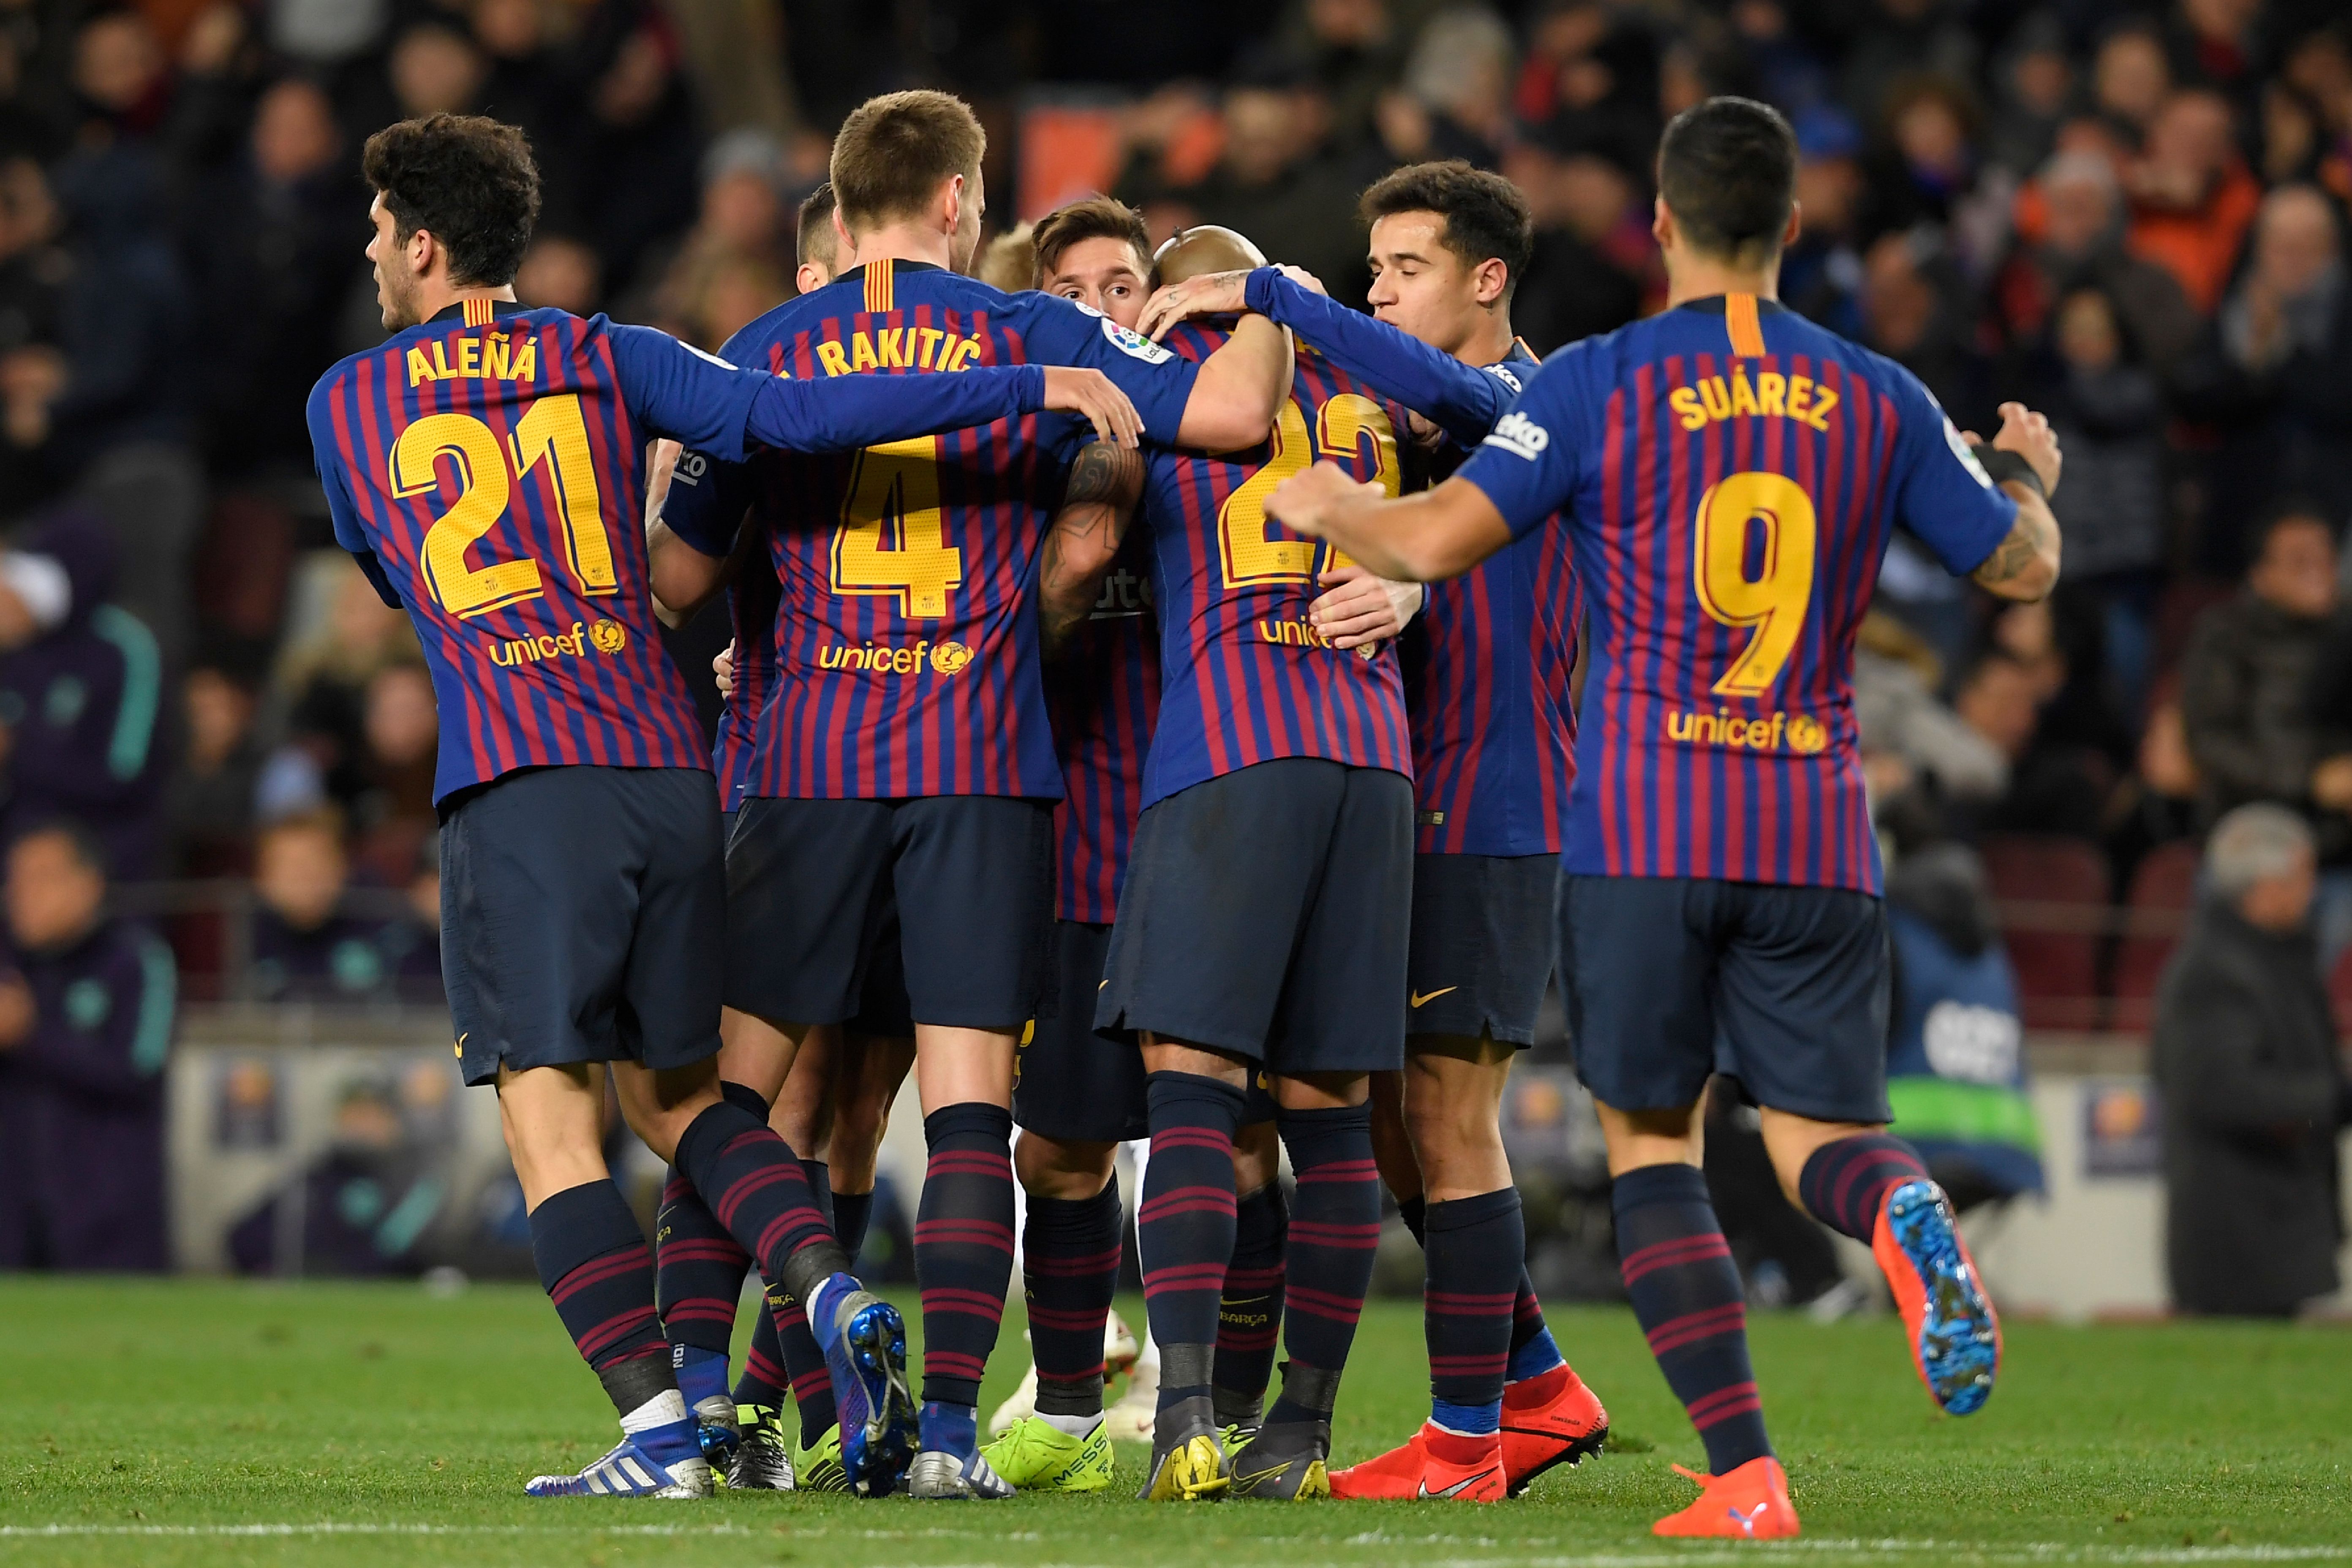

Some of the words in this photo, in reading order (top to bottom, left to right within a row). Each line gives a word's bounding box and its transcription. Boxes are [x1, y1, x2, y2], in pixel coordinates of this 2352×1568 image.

[406, 331, 536, 387] ALEÑÁ
[816, 327, 982, 376] RAKITIĆ
[1669, 365, 1840, 432] SUÁREZ
[388, 393, 619, 620] 21
[831, 435, 961, 618] 4
[1694, 471, 1816, 697] 9
[489, 621, 585, 667] unicef
[819, 640, 928, 674] unicef
[1667, 708, 1786, 748] unicef
[1220, 1311, 1267, 1326] BARÇA
